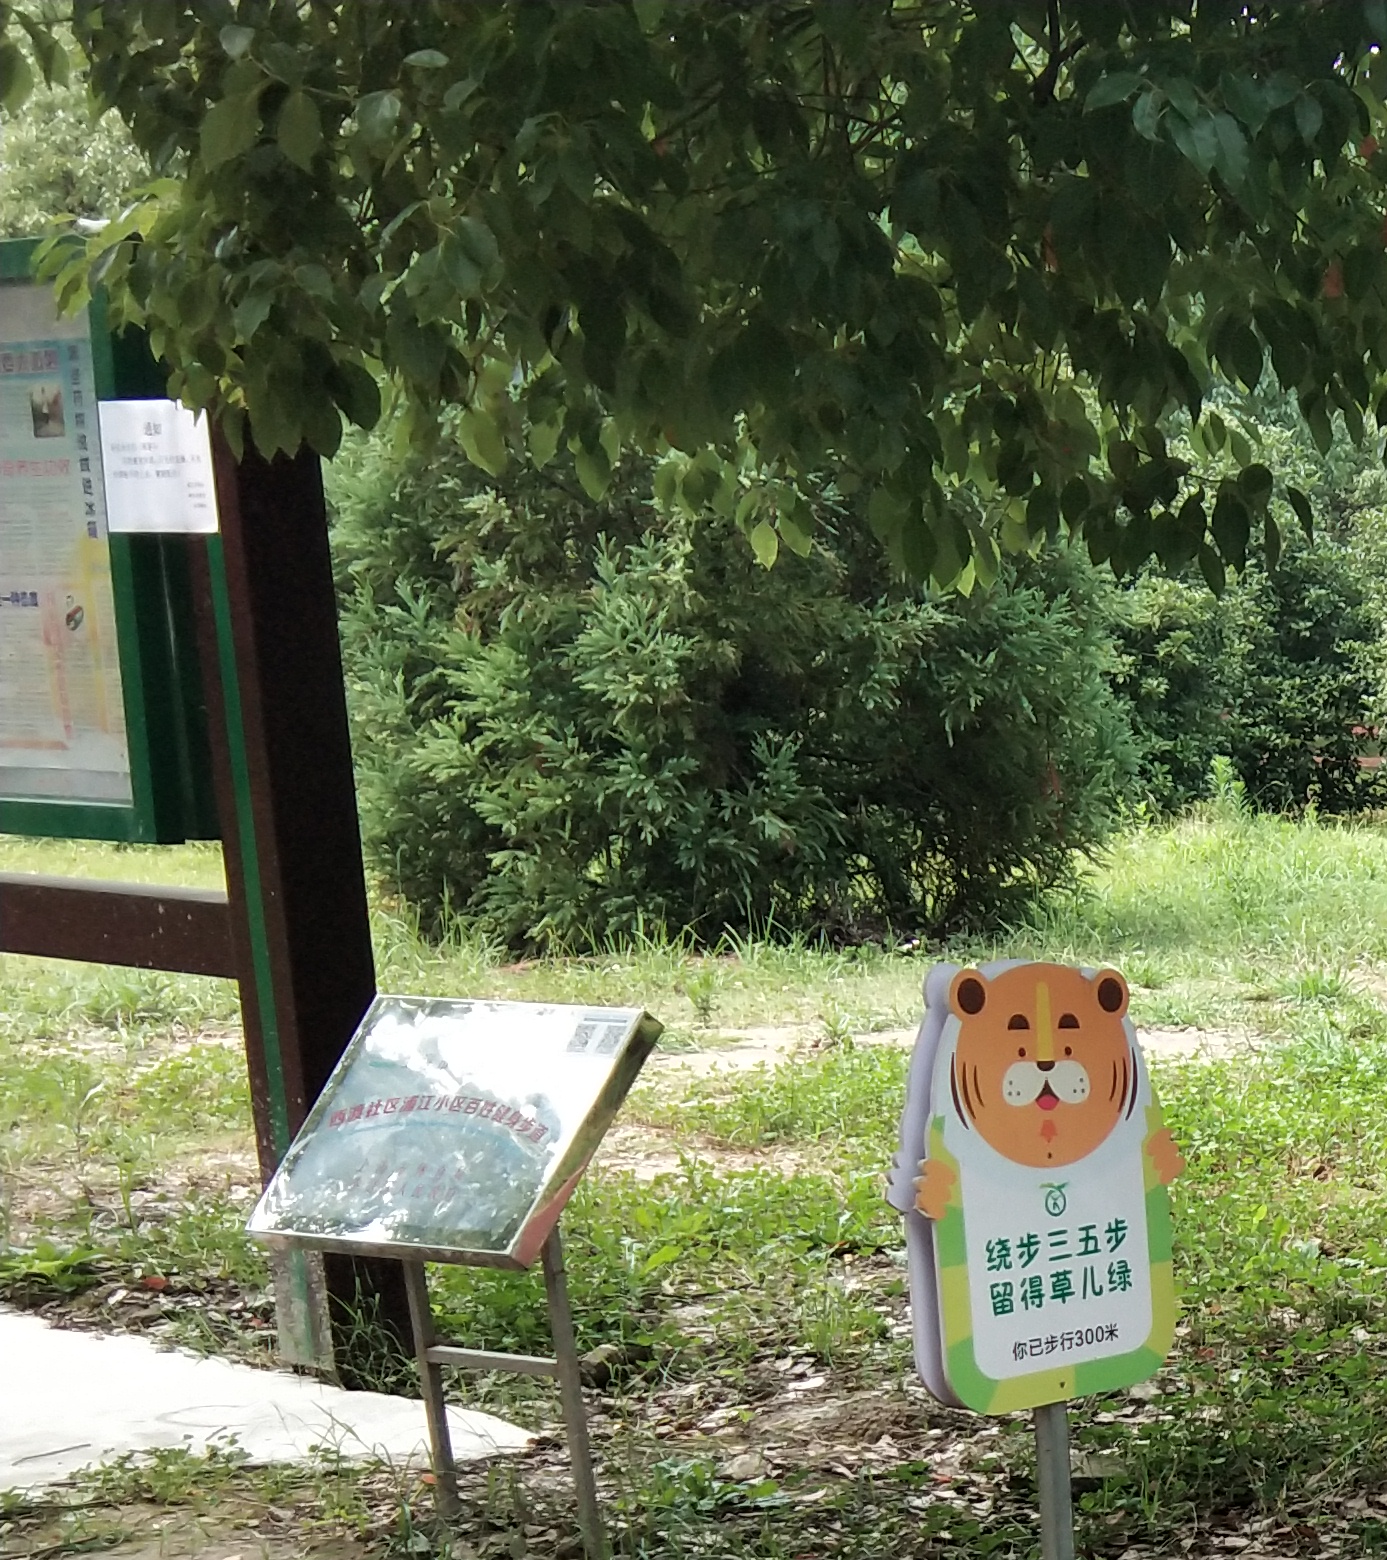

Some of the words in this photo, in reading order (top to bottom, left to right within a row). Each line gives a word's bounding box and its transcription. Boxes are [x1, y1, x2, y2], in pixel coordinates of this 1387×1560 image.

[330, 1096, 548, 1142] 西渡社区浦江小区百姓健身步道
[985, 1218, 1128, 1272] 绕步三五步
[990, 1260, 1132, 1316] 留得草儿绿
[1013, 1324, 1119, 1361] 你已步行300米
